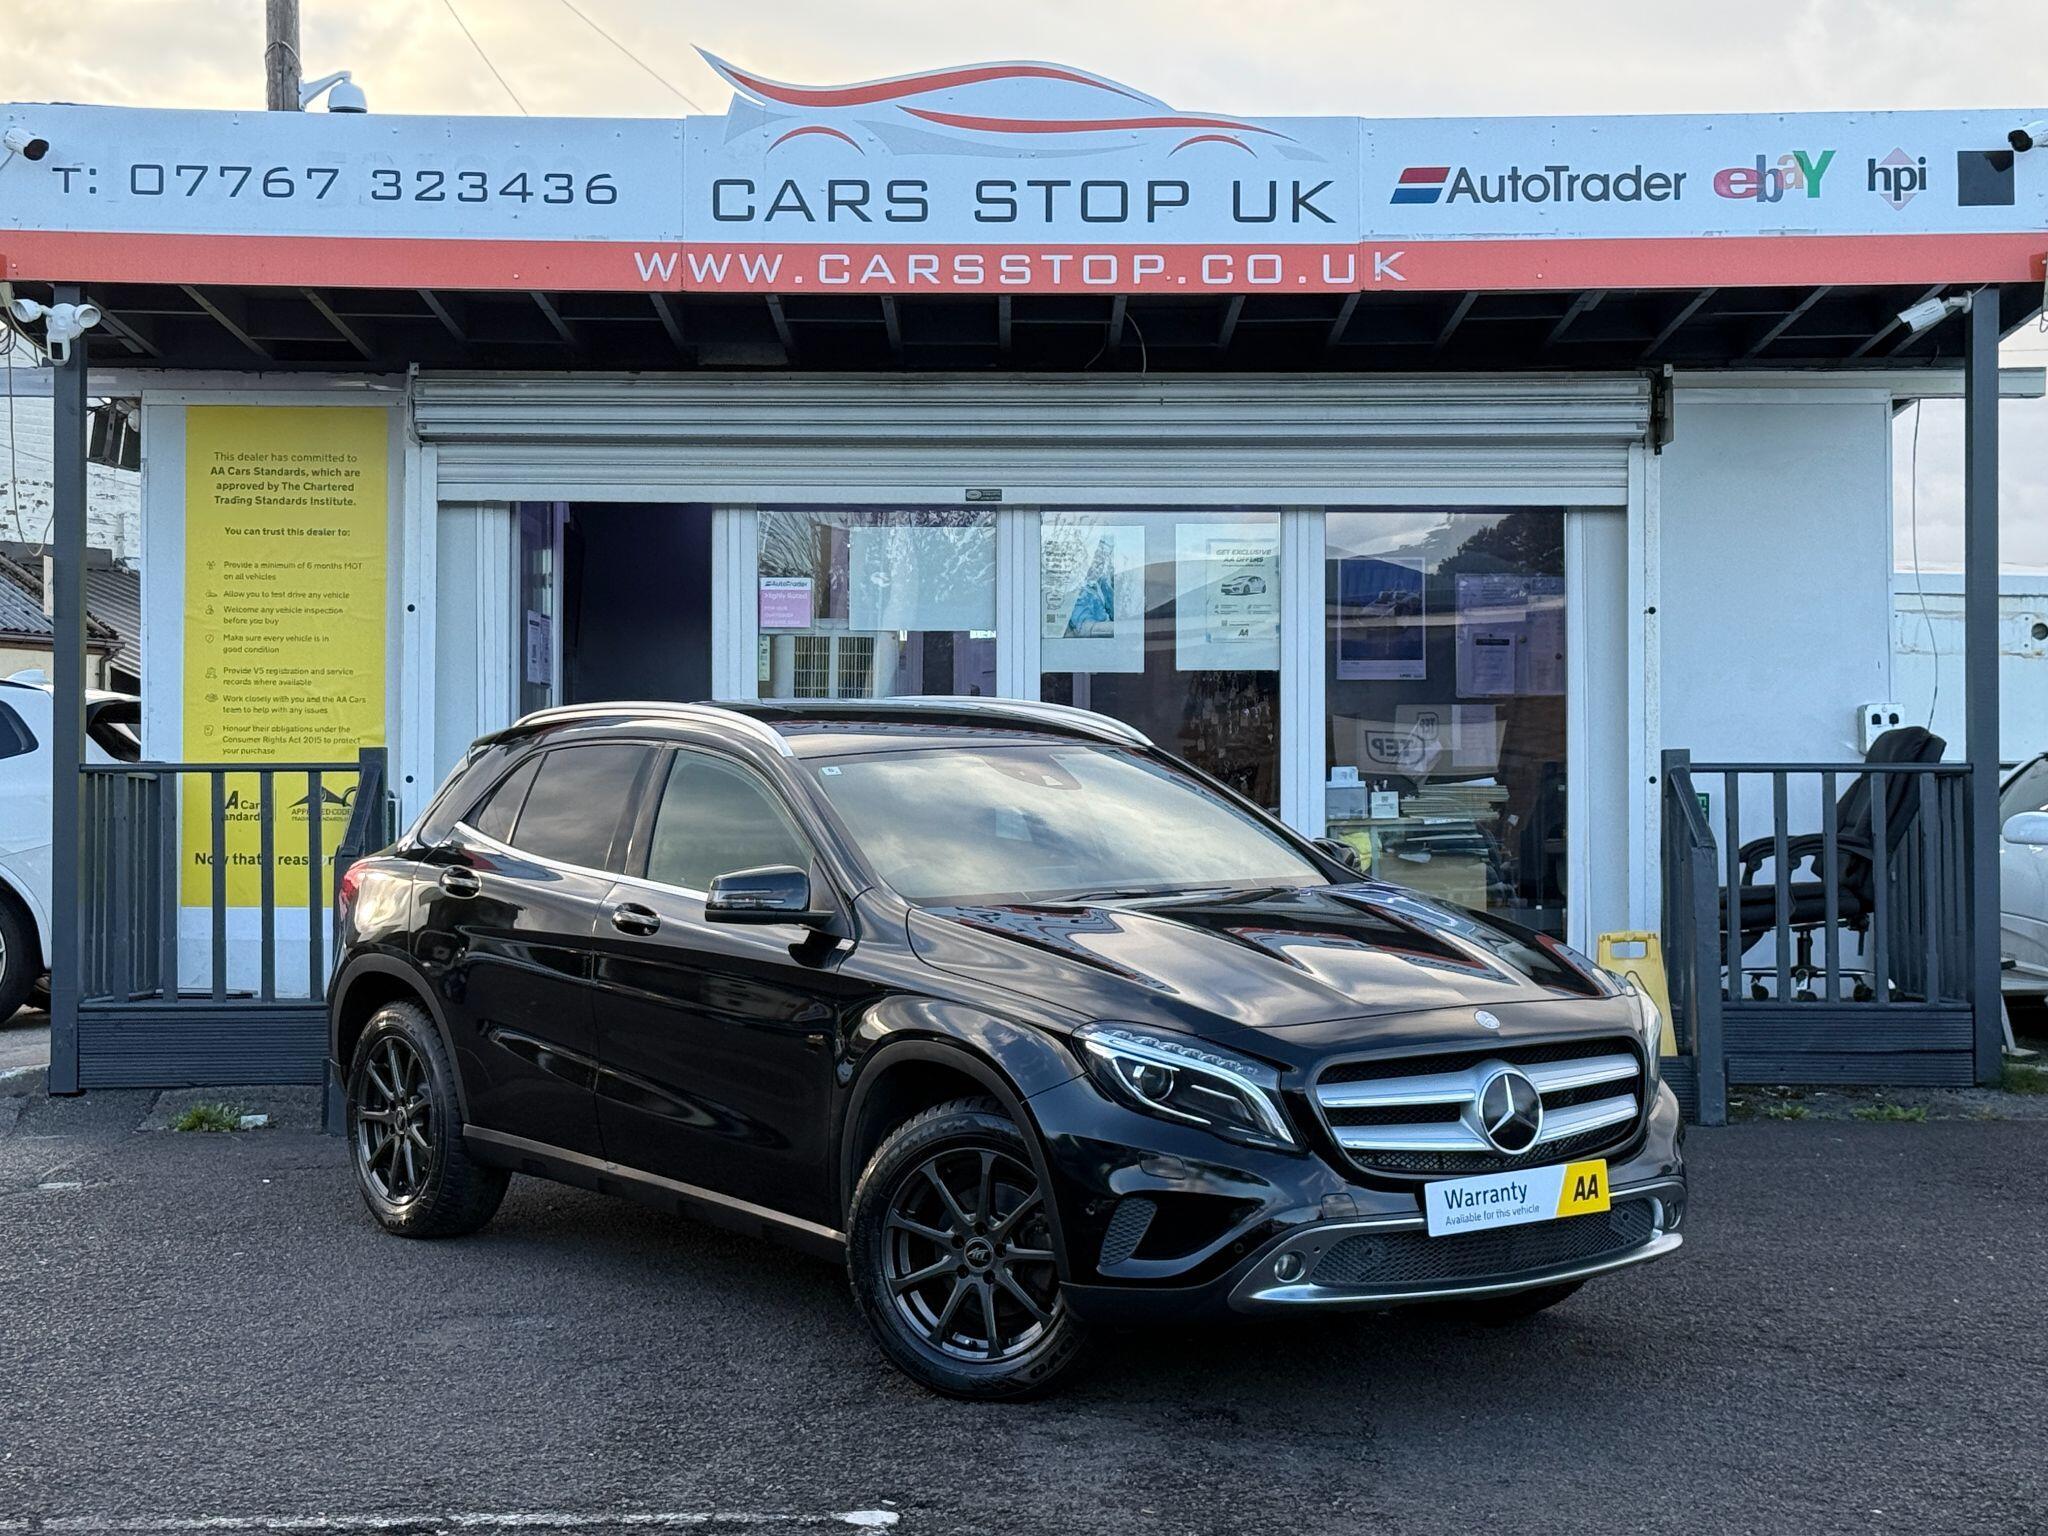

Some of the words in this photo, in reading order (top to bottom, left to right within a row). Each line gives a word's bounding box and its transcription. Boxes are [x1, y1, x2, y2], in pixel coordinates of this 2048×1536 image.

[52, 166, 97, 195] T:
[130, 163, 342, 200] 07767
[371, 168, 619, 205] 323436
[1446, 164, 1687, 205] AutoTrader
[1867, 155, 1928, 206] hpi
[712, 178, 930, 223] CARS
[974, 179, 1191, 224] STOP
[1231, 180, 1337, 224] UK
[634, 250, 1407, 286] WWW.CARSSTOP.CO.UK
[214, 452, 235, 461] This
[237, 452, 269, 461] dealer
[271, 452, 289, 461] has
[291, 452, 345, 461] committed
[347, 453, 358, 462] to
[210, 467, 226, 476] AA
[228, 467, 251, 476] Cars
[312, 469, 342, 477] which
[214, 495, 253, 506] Trading
[255, 496, 308, 505] Standards
[216, 482, 265, 492] approved
[267, 482, 280, 493] by
[282, 482, 301, 491] The
[303, 482, 355, 491] Chartered
[225, 527, 241, 536] You
[244, 528, 261, 536] can
[262, 527, 286, 536] trust
[287, 527, 304, 536] this
[307, 527, 336, 536] dealer
[233, 853, 263, 866] that
[1444, 1181, 1528, 1210] Warranty
[1573, 1174, 1599, 1202] AA
[1445, 1213, 1482, 1227] Available
[1483, 1210, 1495, 1221] for
[1496, 1208, 1511, 1219] this
[1512, 1203, 1541, 1216] vehicle
